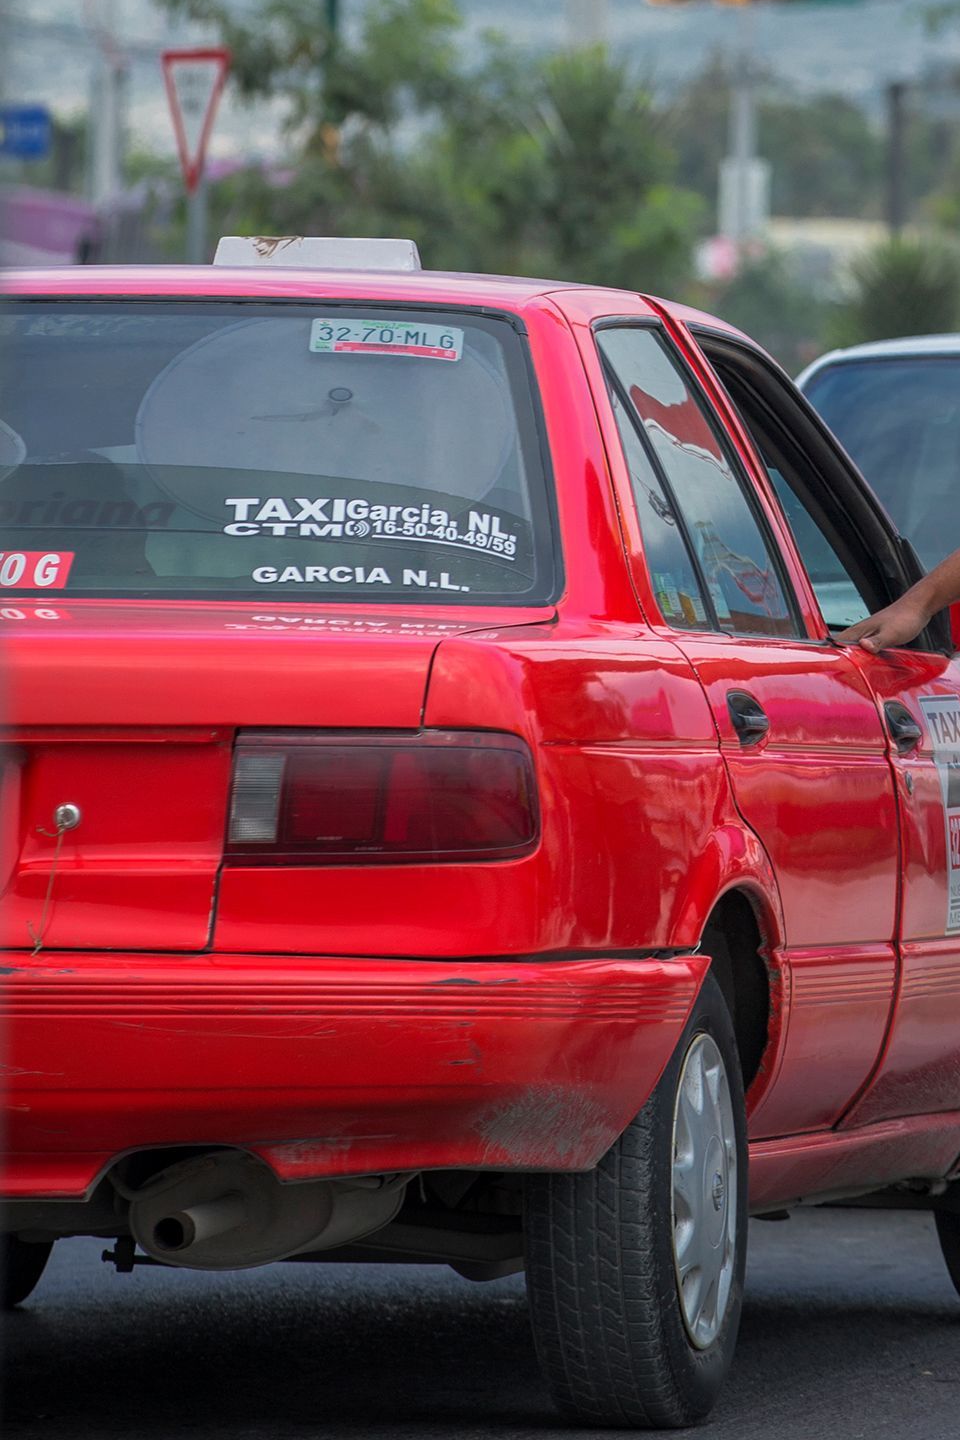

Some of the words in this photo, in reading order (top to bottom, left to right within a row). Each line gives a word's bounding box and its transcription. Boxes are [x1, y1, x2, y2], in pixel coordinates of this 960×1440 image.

[319, 326, 454, 349] 32-70-MLG
[225, 498, 347, 522] TAXI
[223, 522, 343, 537] CTM
[373, 520, 516, 555] 16-50-40-49/59
[33, 553, 61, 587] G
[252, 566, 391, 584] GARCIA
[403, 569, 470, 592] N.L.
